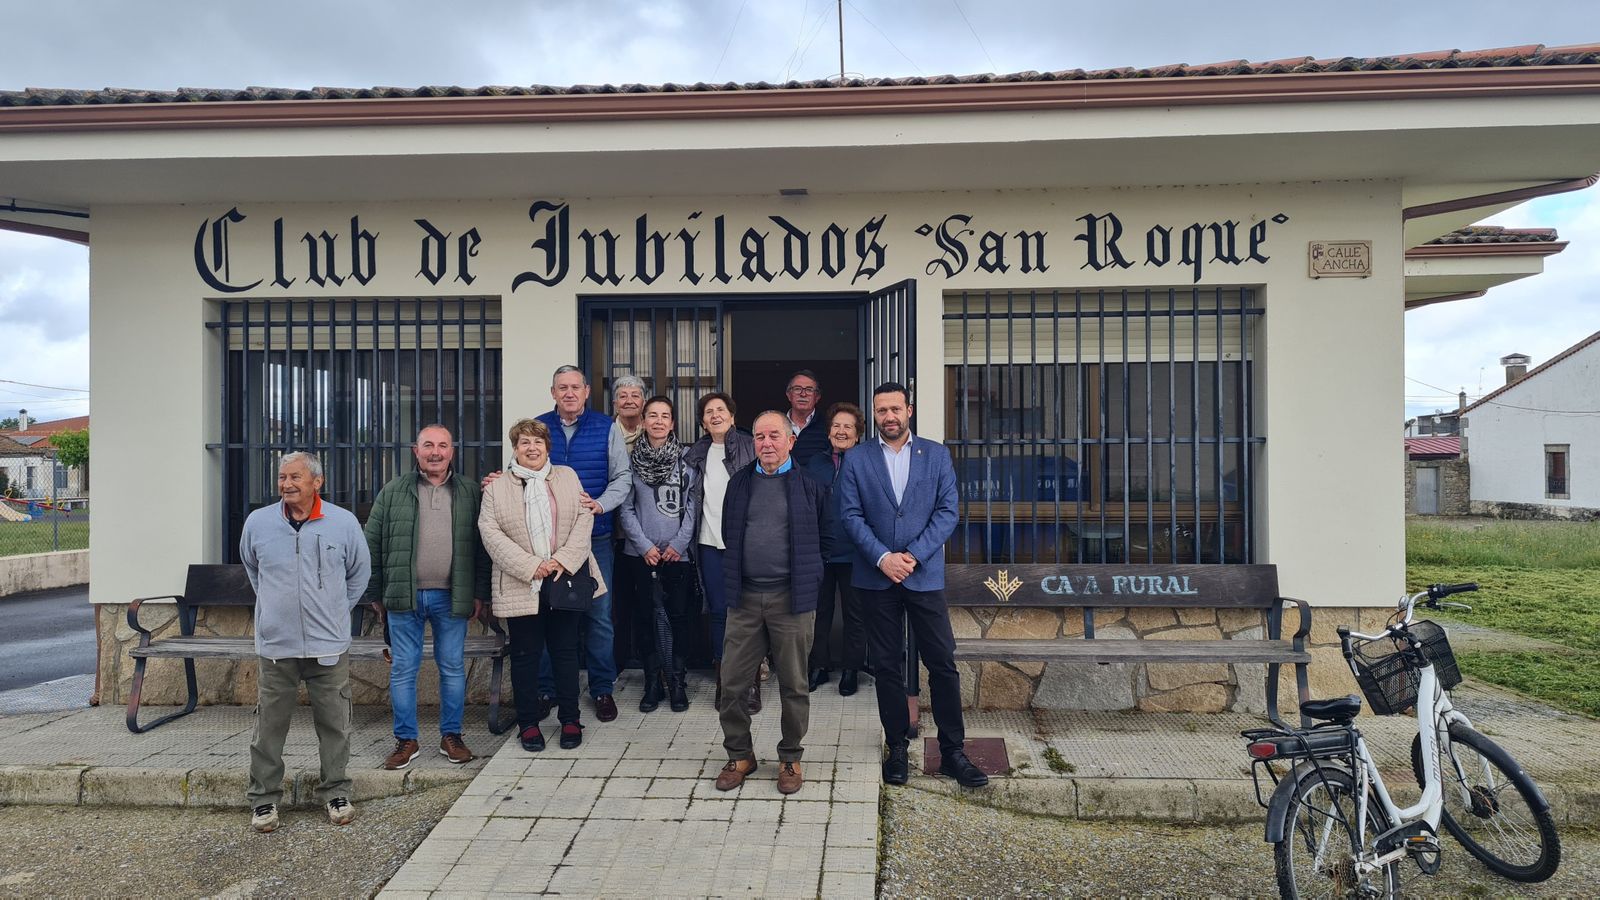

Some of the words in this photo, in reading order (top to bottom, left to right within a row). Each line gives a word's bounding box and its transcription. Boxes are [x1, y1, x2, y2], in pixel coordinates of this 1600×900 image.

[194, 206, 380, 293] Club
[413, 218, 482, 286] de
[511, 199, 888, 294] Jubilados
[1327, 247, 1361, 258] CALLE
[1322, 259, 1365, 270] ANCHA
[1112, 575, 1198, 595] RURAL
